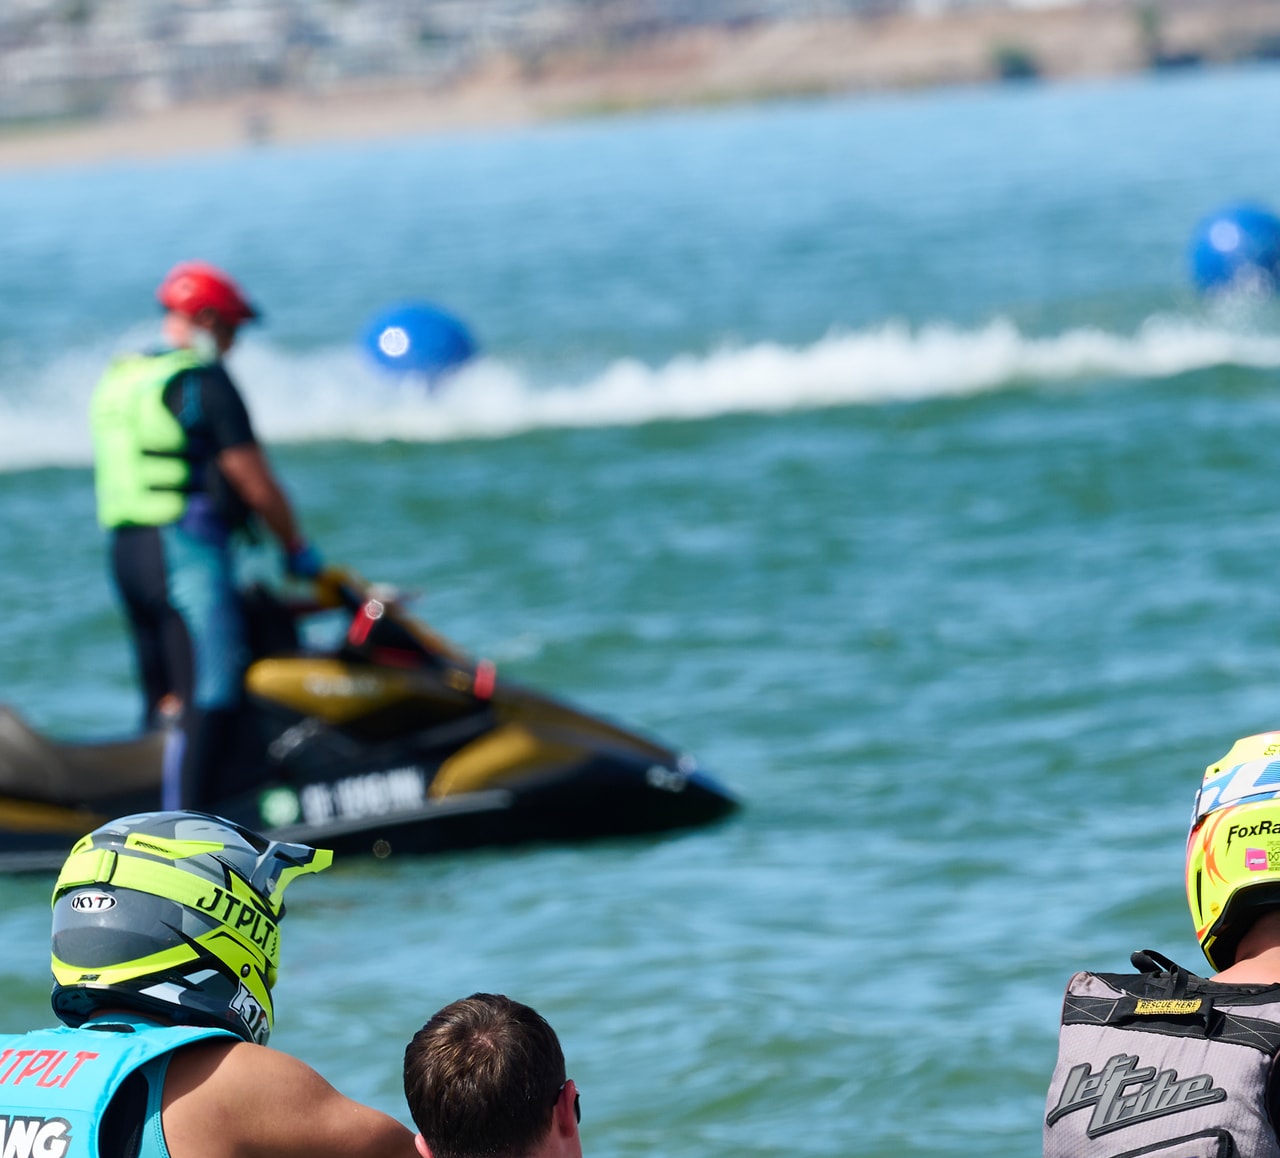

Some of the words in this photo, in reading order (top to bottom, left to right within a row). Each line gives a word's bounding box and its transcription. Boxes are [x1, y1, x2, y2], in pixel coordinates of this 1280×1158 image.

[75, 896, 110, 909] KYT
[196, 887, 274, 951] JTPLT
[1140, 1001, 1173, 1010] RESCUE
[1175, 1000, 1198, 1009] HERE
